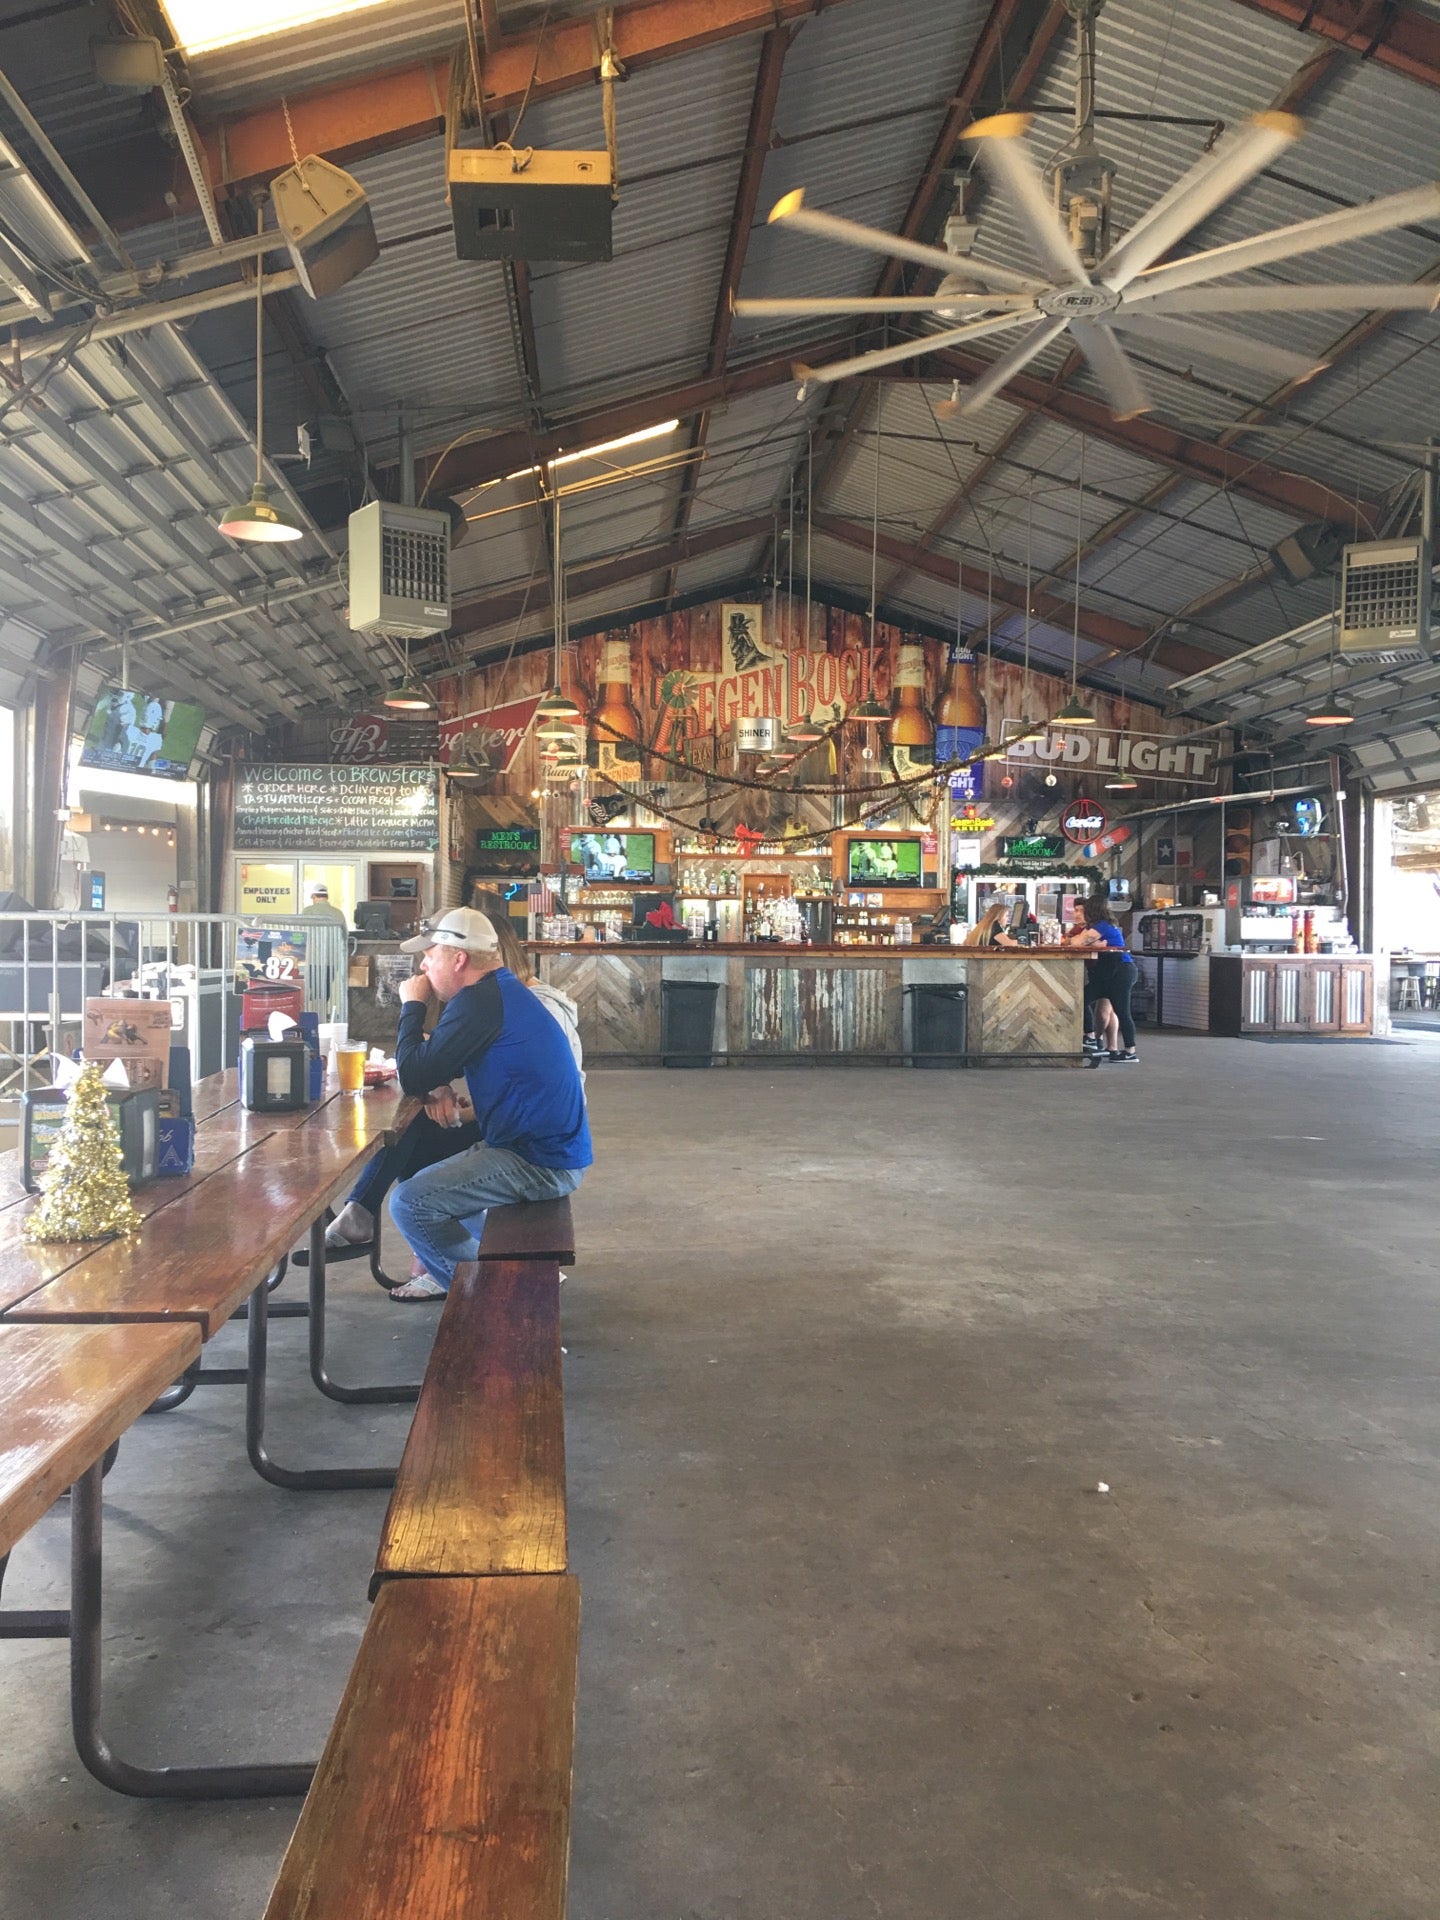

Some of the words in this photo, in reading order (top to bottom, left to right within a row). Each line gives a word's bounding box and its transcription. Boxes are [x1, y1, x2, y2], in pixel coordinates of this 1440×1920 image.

[952, 652, 974, 660] LIGHT
[739, 728, 771, 738] SHINER
[1006, 730, 1091, 763] BUD
[1096, 737, 1212, 776] LIGHT
[244, 765, 323, 782] Welcome
[328, 767, 346, 782] to
[947, 776, 976, 788] GHT
[243, 793, 277, 804] TASTY
[492, 831, 521, 841] MEN'S
[480, 840, 533, 850] RESTROOM
[243, 887, 290, 895] EMPLOYEES
[256, 896, 277, 904] ONLY
[265, 956, 295, 980] 82
